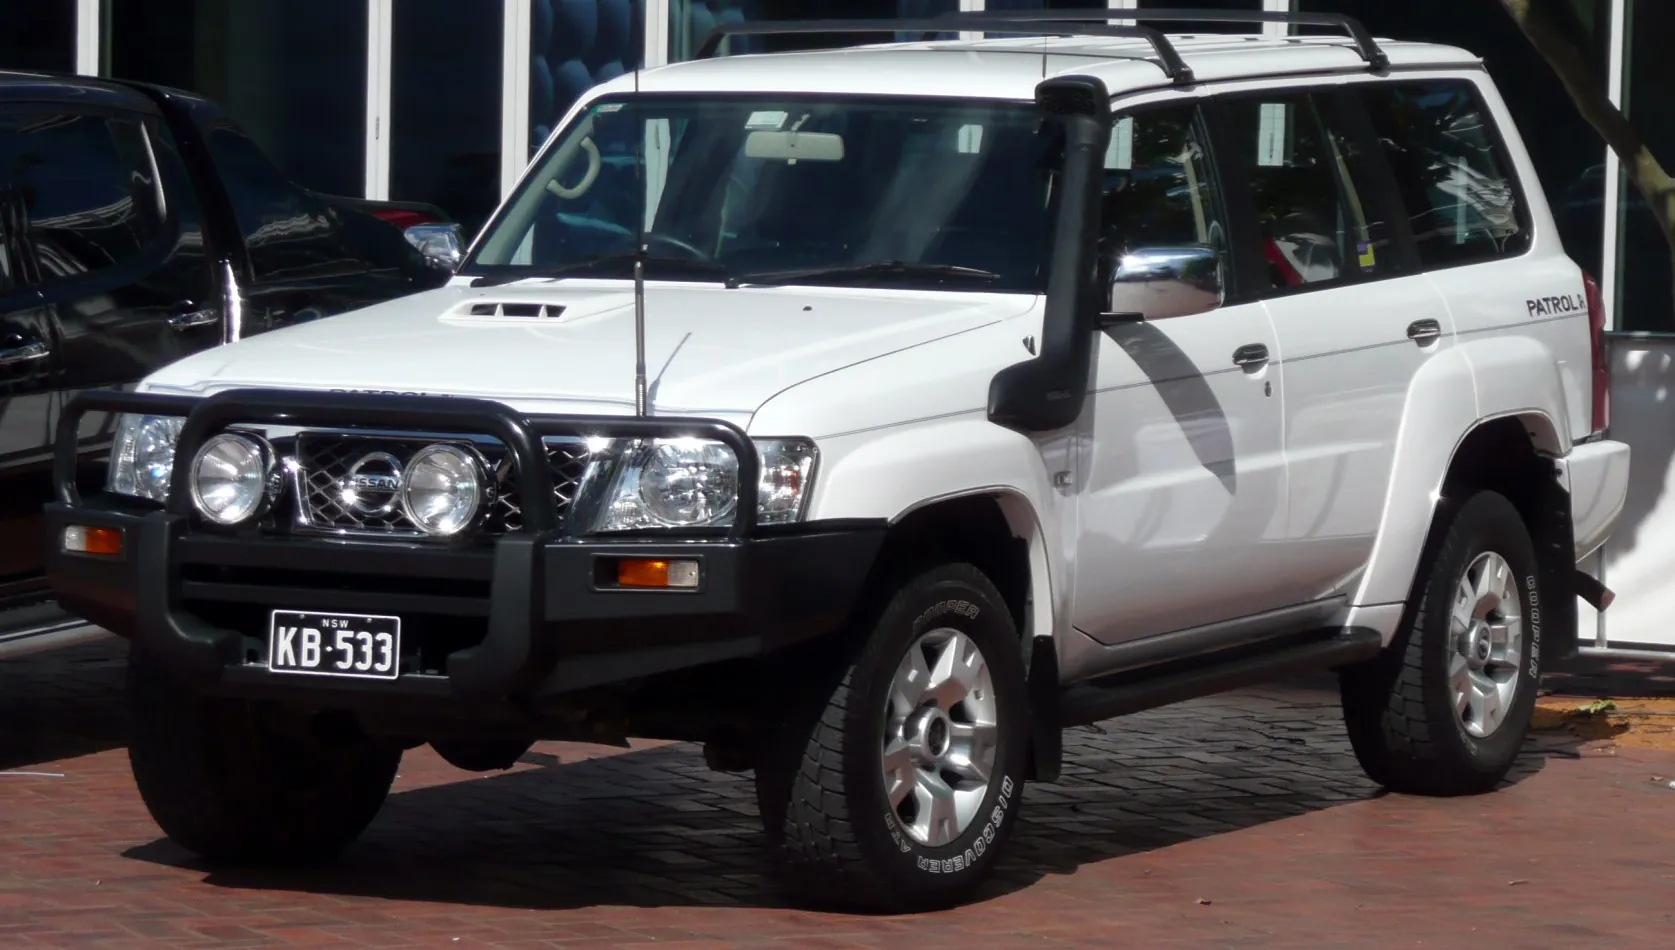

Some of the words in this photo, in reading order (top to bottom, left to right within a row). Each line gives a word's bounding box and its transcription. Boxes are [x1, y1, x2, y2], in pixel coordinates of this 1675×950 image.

[1526, 294, 1579, 318] PATROL
[344, 477, 399, 490] ISSAN
[322, 619, 349, 628] NSW
[917, 775, 1013, 873] DISCOVERER
